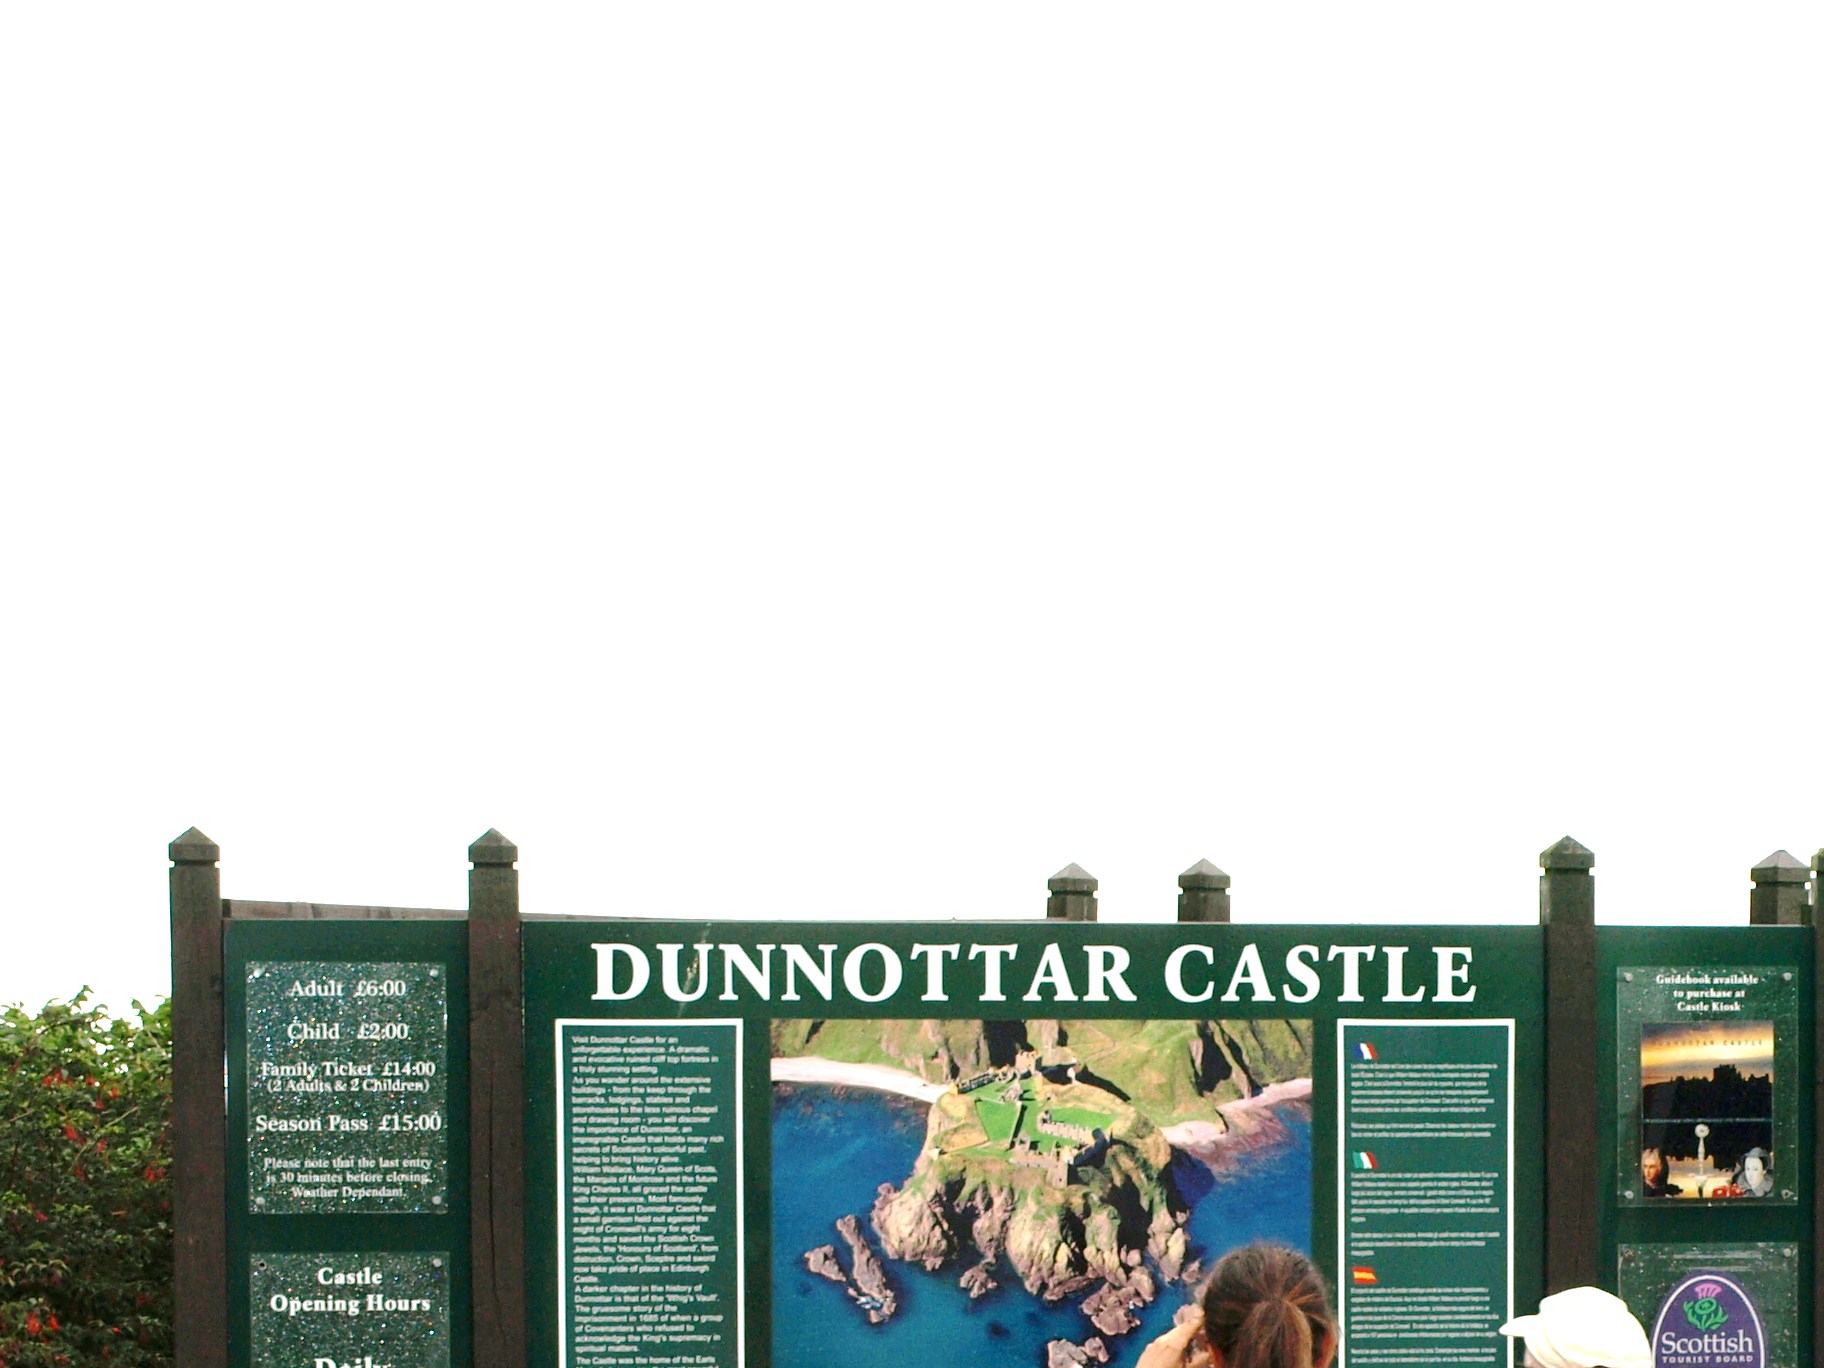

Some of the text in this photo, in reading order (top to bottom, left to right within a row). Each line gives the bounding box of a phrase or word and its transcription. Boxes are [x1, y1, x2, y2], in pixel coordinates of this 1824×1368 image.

[591, 942, 1477, 1003] DUNNOTTAR CASTLE
[1656, 974, 1758, 984] Guidebook available
[289, 980, 406, 997] Adult £6:00
[1674, 989, 1745, 999] to purchase at
[1677, 1002, 1741, 1011] Castle Kiosk
[287, 1023, 408, 1039] Child £2:00
[262, 1062, 435, 1080] Family Ticket £14:00
[267, 1079, 429, 1092] (2 Adults & 2 Children)
[256, 1114, 441, 1131] Season Pass £15:00
[264, 1158, 432, 1170] Please note that the last entry
[267, 1173, 277, 1182] is
[280, 1173, 294, 1182] 30
[297, 1173, 342, 1182] minutes
[347, 1172, 382, 1182] before
[291, 1187, 338, 1197] Weather
[317, 1267, 382, 1285] Castle
[270, 1294, 430, 1316] Opening Hours
[1662, 1329, 1753, 1355] Scottish
[1662, 1355, 1753, 1364] TOURIST BOARD
